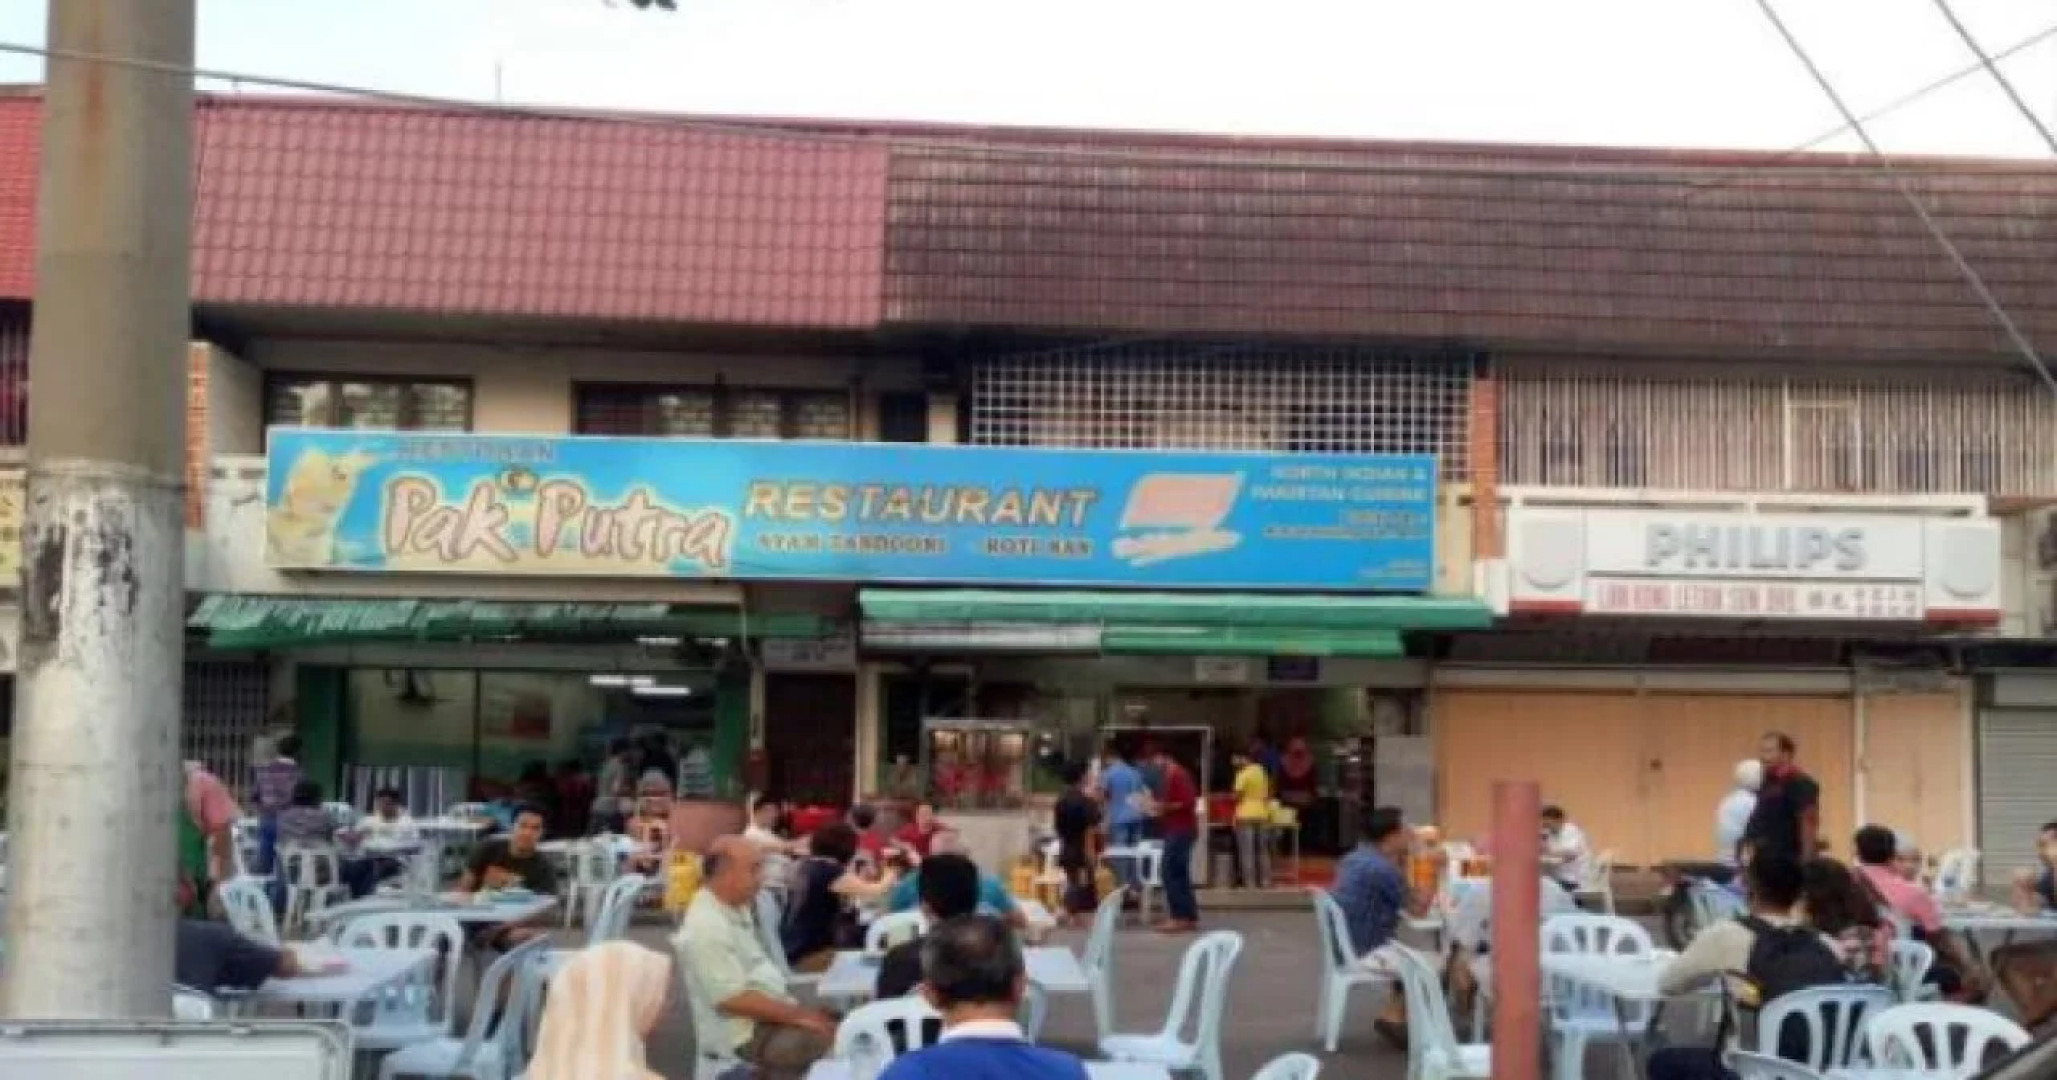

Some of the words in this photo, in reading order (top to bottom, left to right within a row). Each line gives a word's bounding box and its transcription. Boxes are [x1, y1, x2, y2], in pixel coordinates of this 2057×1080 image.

[384, 474, 519, 563] Pak
[536, 479, 729, 568] Putra
[745, 479, 1099, 527] RESTAURANT
[1645, 522, 1868, 571] PHILIPS
